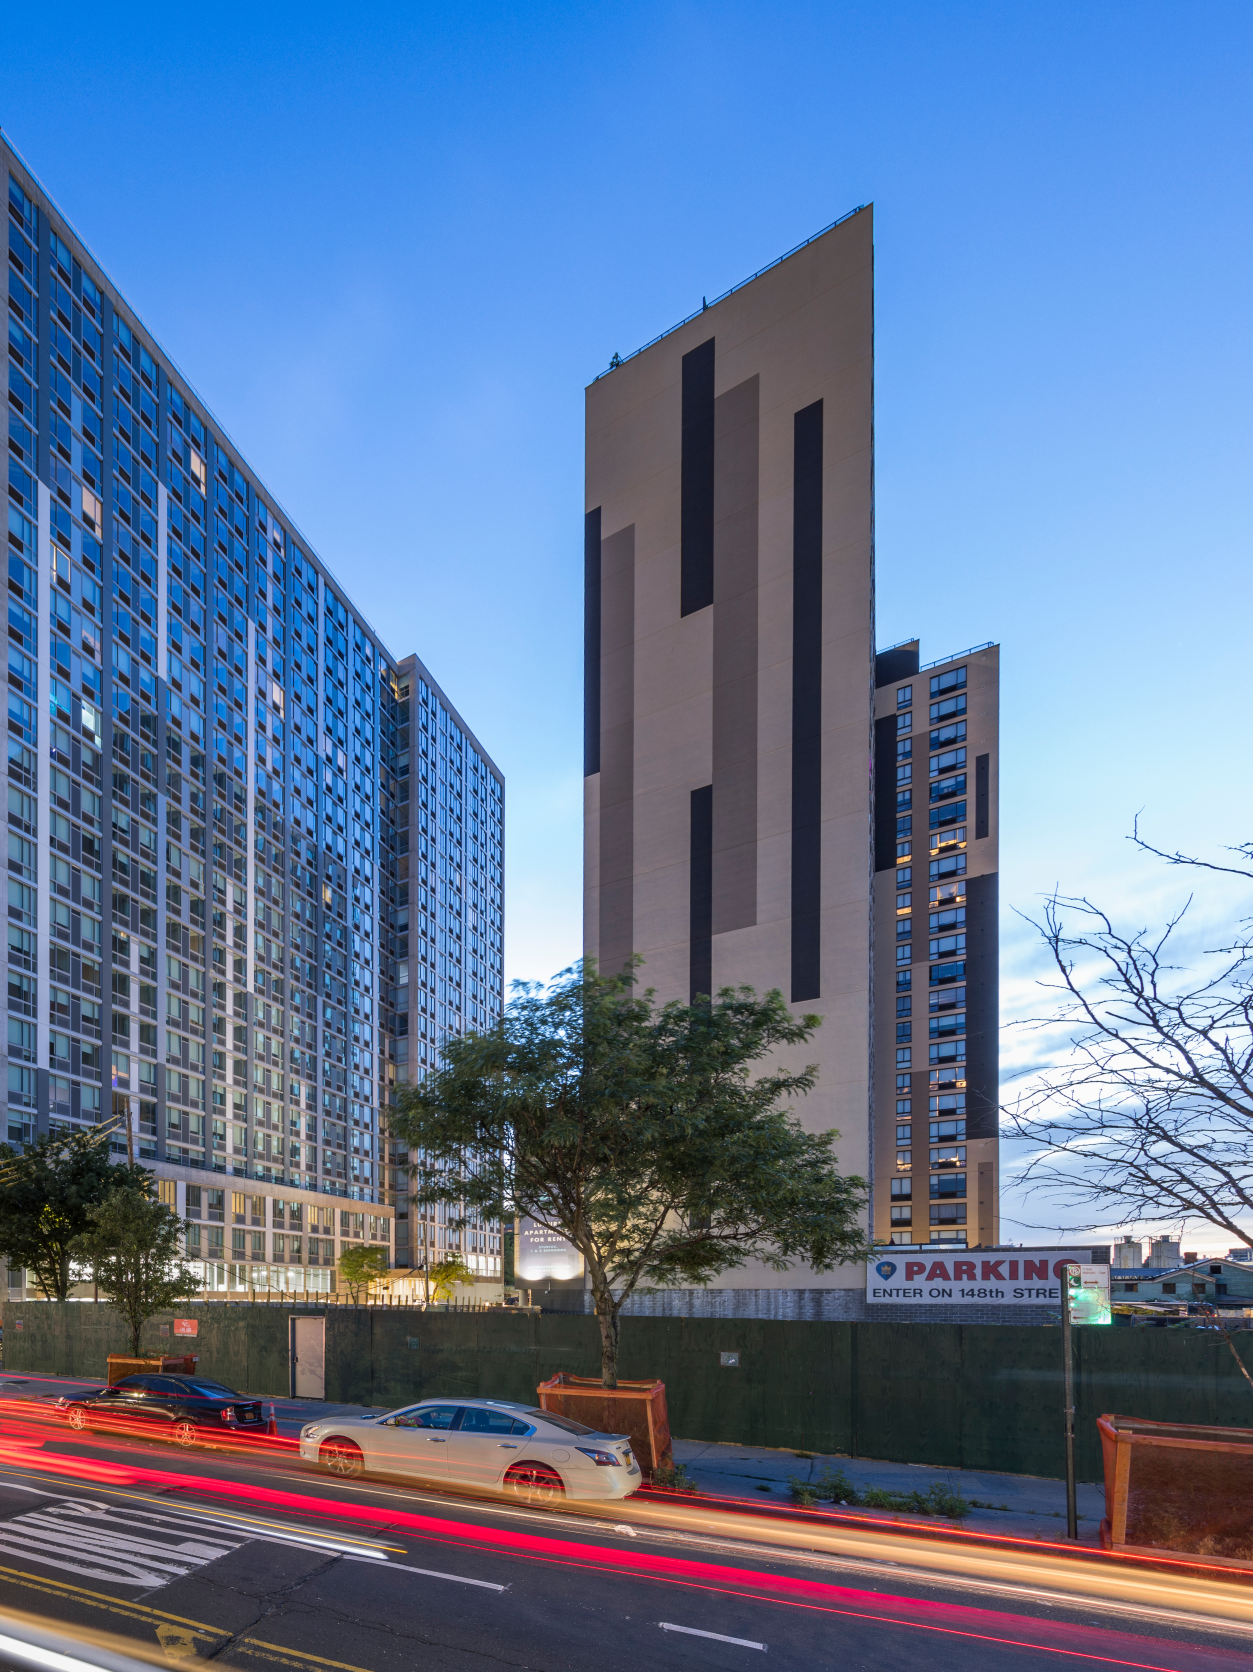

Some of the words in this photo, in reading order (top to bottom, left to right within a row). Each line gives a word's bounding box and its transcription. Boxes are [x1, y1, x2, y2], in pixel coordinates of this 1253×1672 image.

[872, 1288, 923, 1298] ENTER
[928, 1288, 953, 1298] ON
[958, 1287, 1005, 1299] 148th
[1012, 1287, 1059, 1299] STRE
